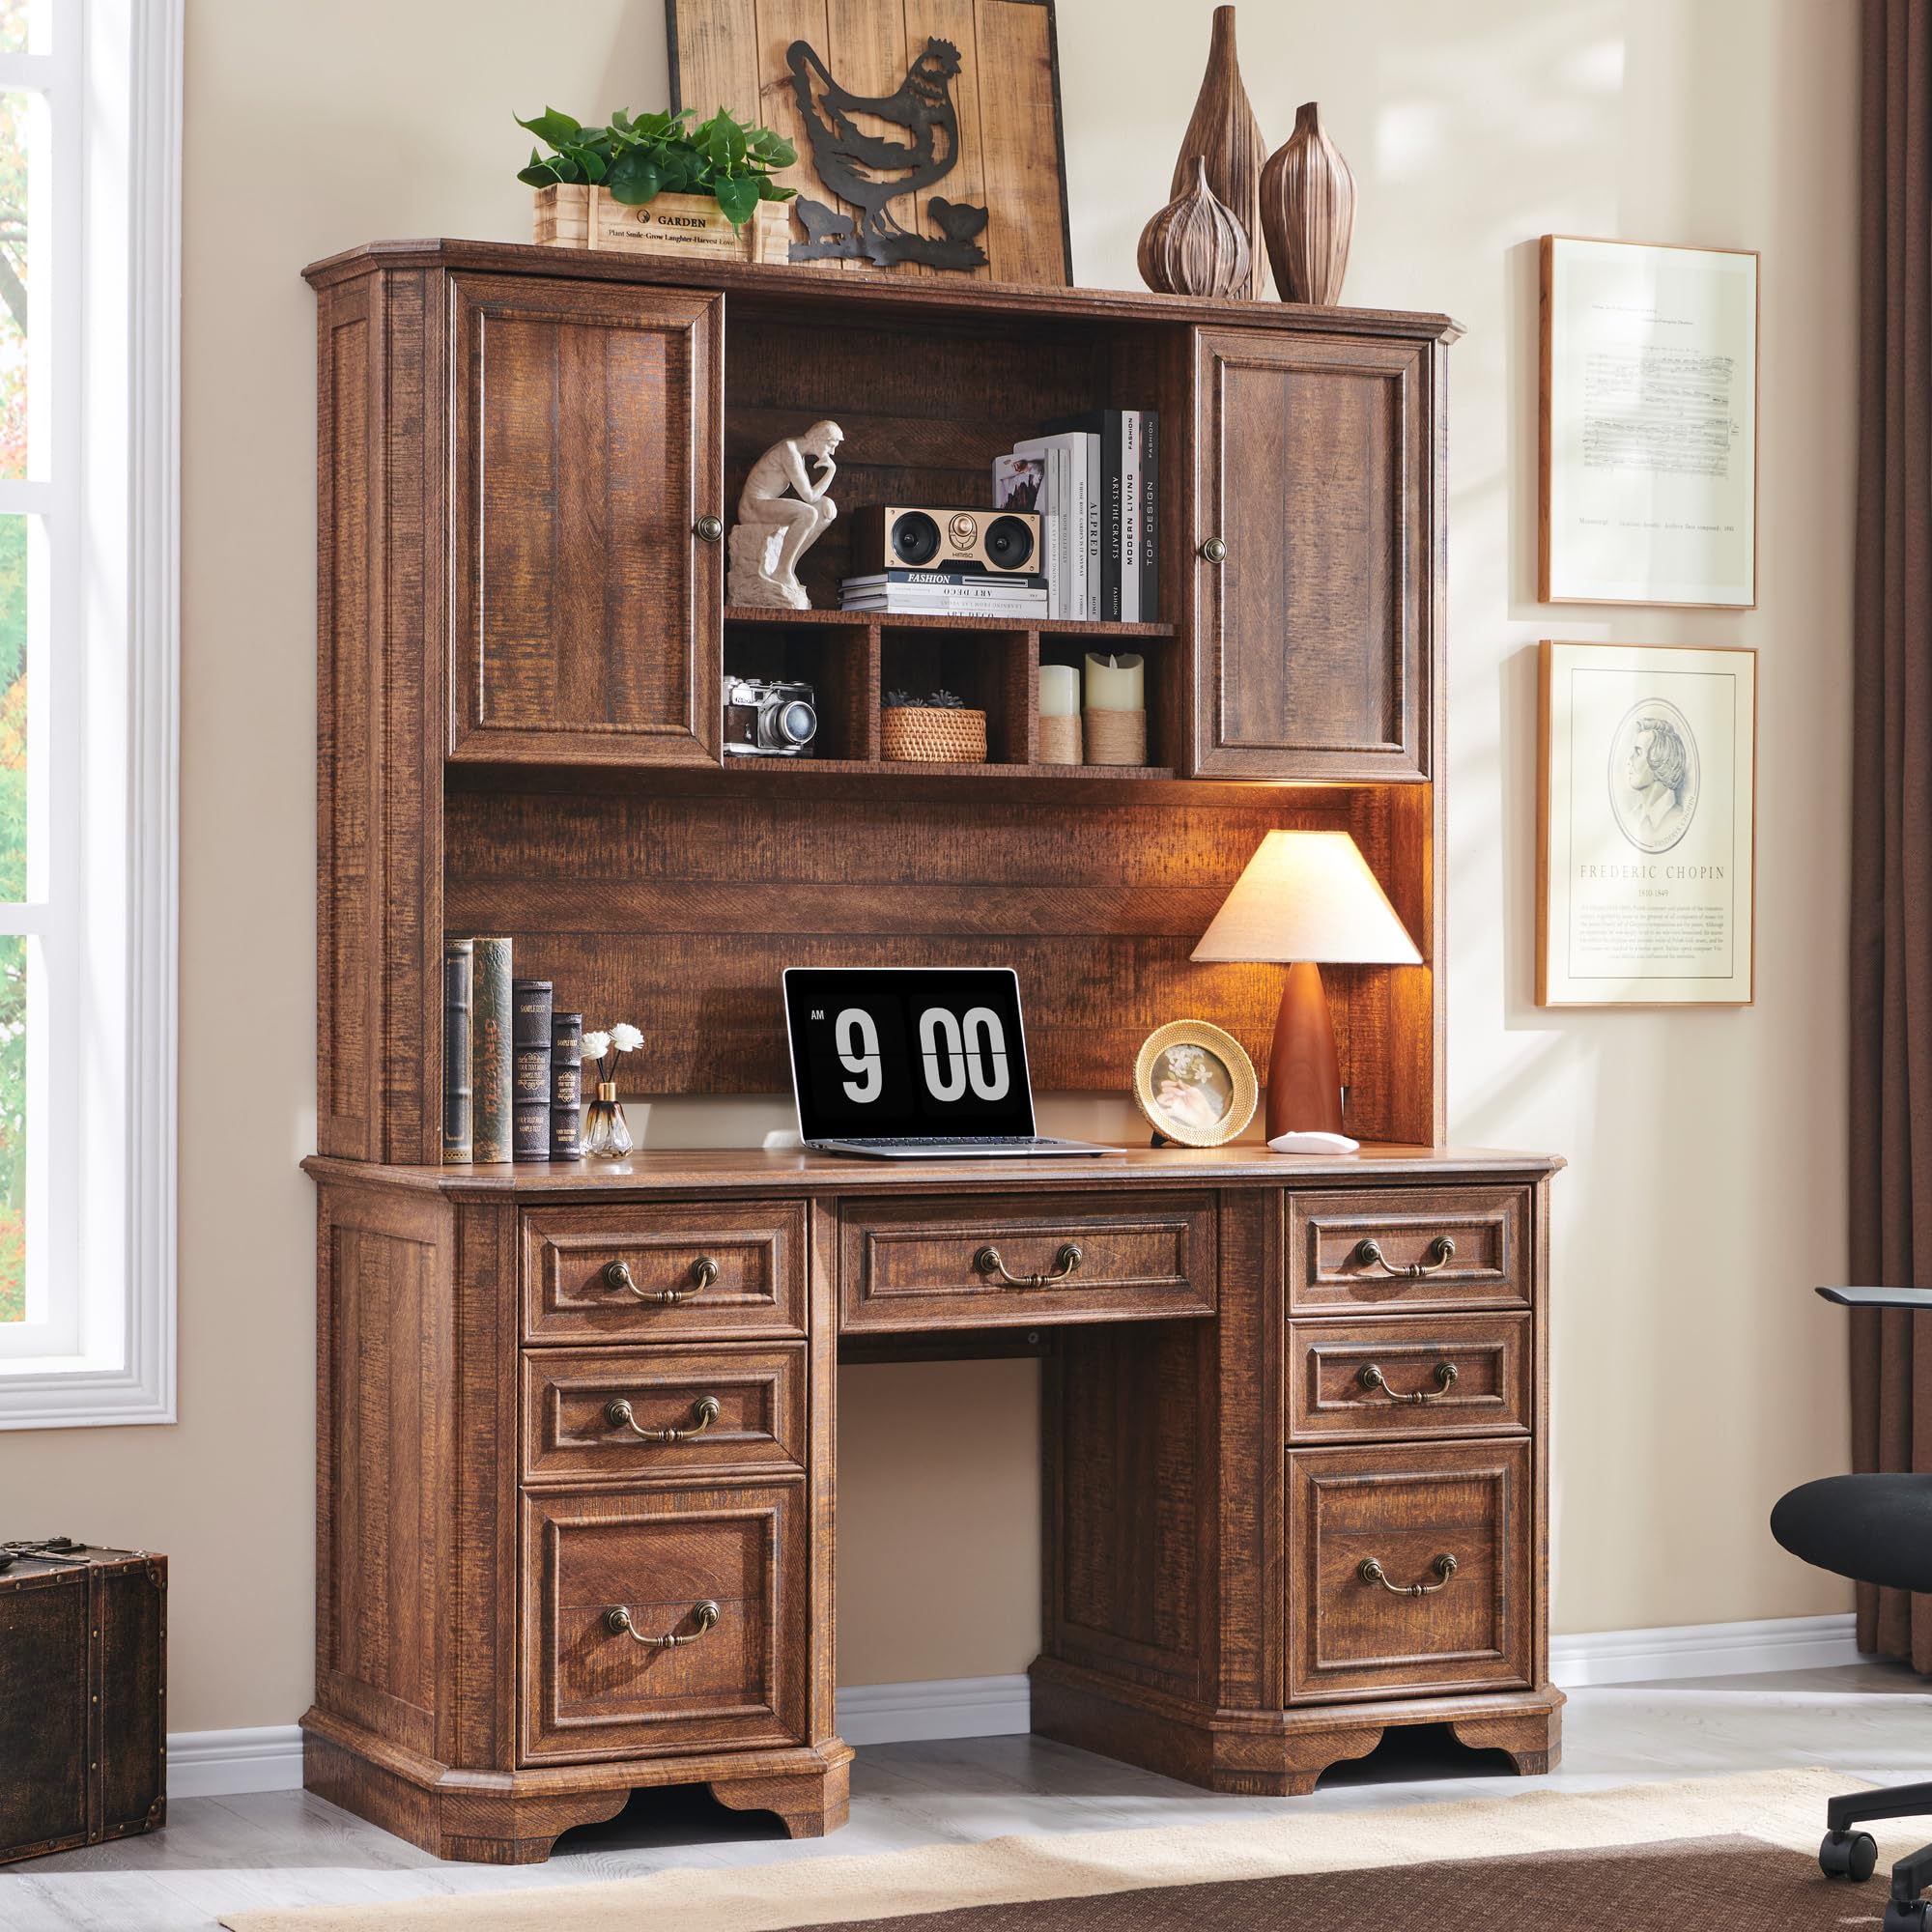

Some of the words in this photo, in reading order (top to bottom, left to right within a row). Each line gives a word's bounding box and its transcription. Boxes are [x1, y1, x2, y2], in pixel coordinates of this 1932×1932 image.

[658, 215, 706, 228] GARDEN
[907, 573, 951, 584] FASHION
[1579, 865, 1658, 879] FREDERIC
[1665, 866, 1724, 879] CHOPIN
[810, 1009, 825, 1020] AM
[835, 1008, 883, 1104] 9
[919, 1007, 1010, 1102] 00
